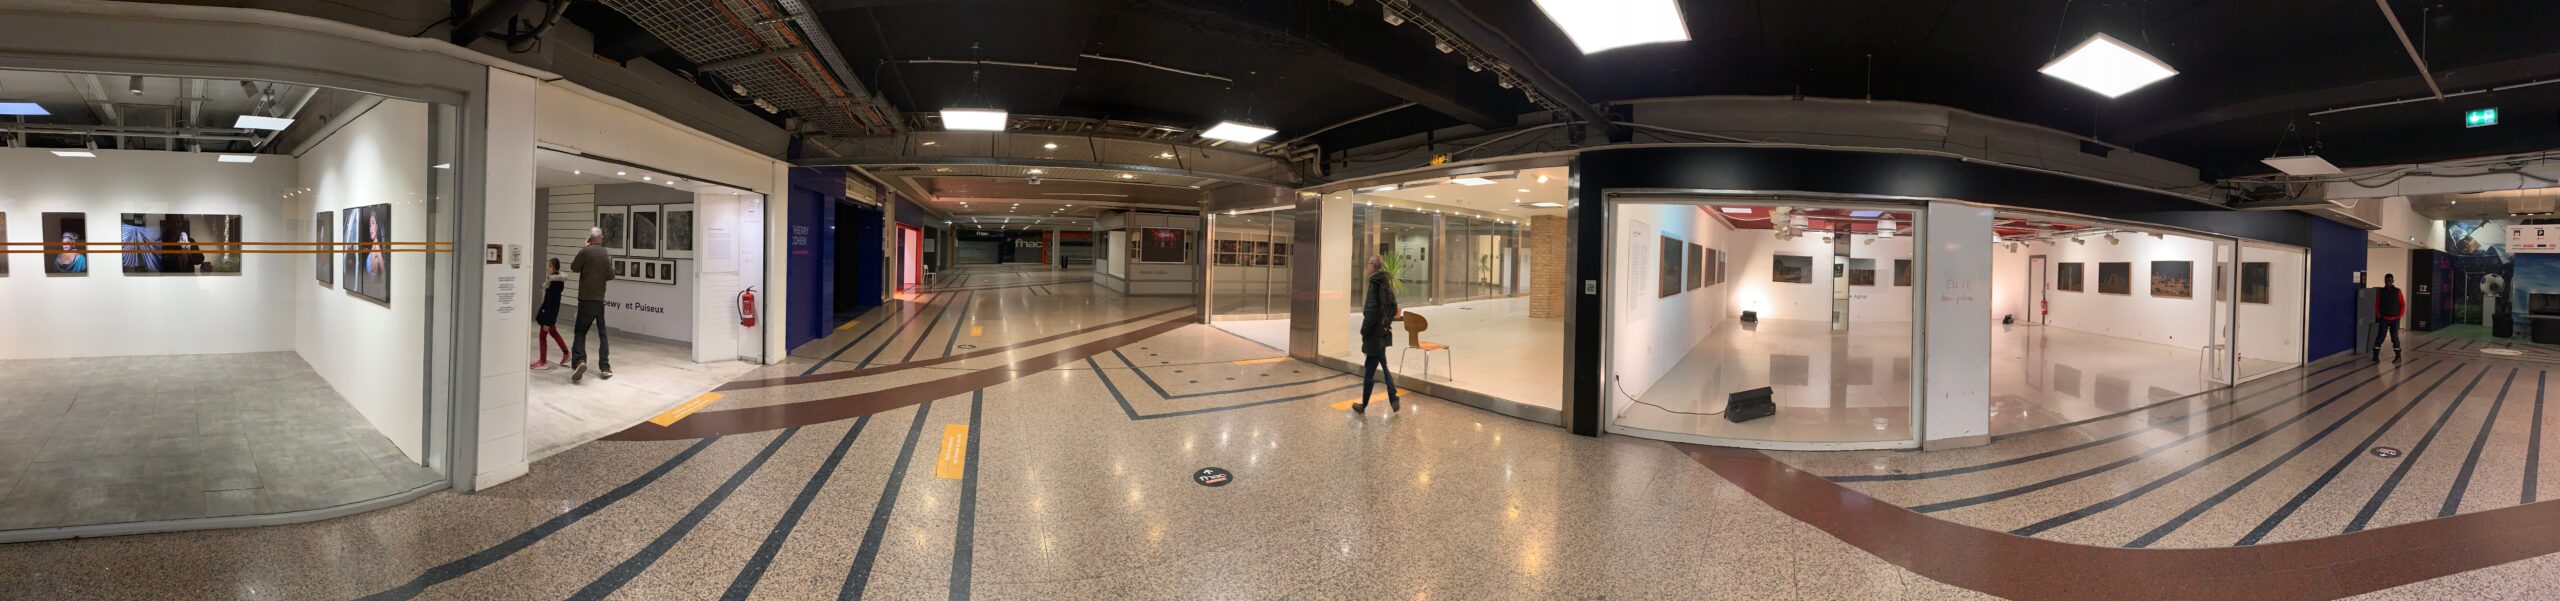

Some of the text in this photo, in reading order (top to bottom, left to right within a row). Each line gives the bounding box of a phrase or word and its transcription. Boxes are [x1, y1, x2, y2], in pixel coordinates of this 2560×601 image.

[1015, 238, 1043, 248] fnac
[625, 302, 633, 310] et
[635, 302, 664, 314] Puiseux
